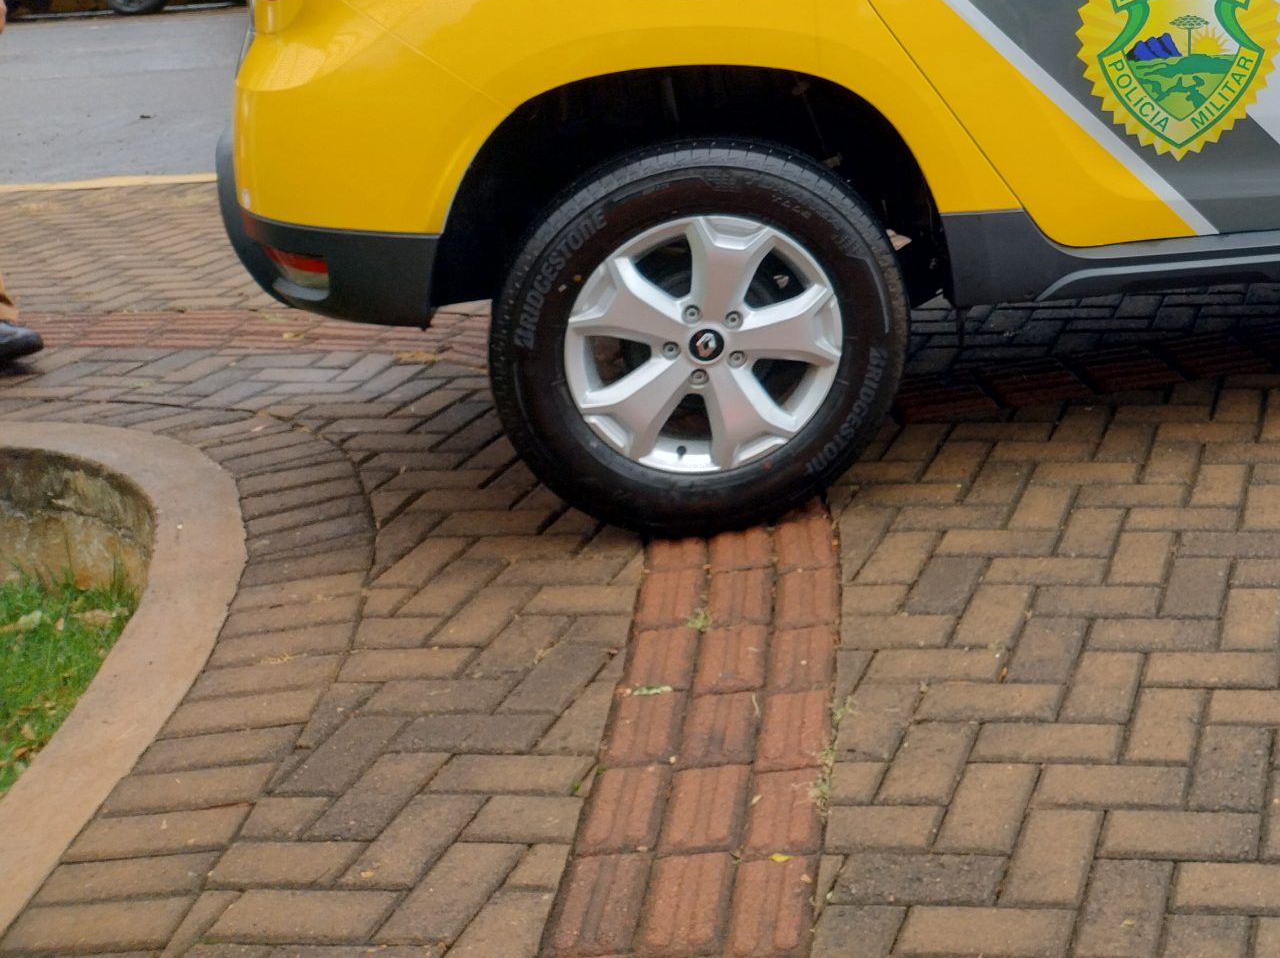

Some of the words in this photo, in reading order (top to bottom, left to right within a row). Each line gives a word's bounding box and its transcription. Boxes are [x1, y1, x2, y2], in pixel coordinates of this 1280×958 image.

[1108, 58, 1170, 133] POLÍCIA
[1189, 55, 1254, 130] MILITAR
[513, 207, 608, 350] BRIDGESTONE
